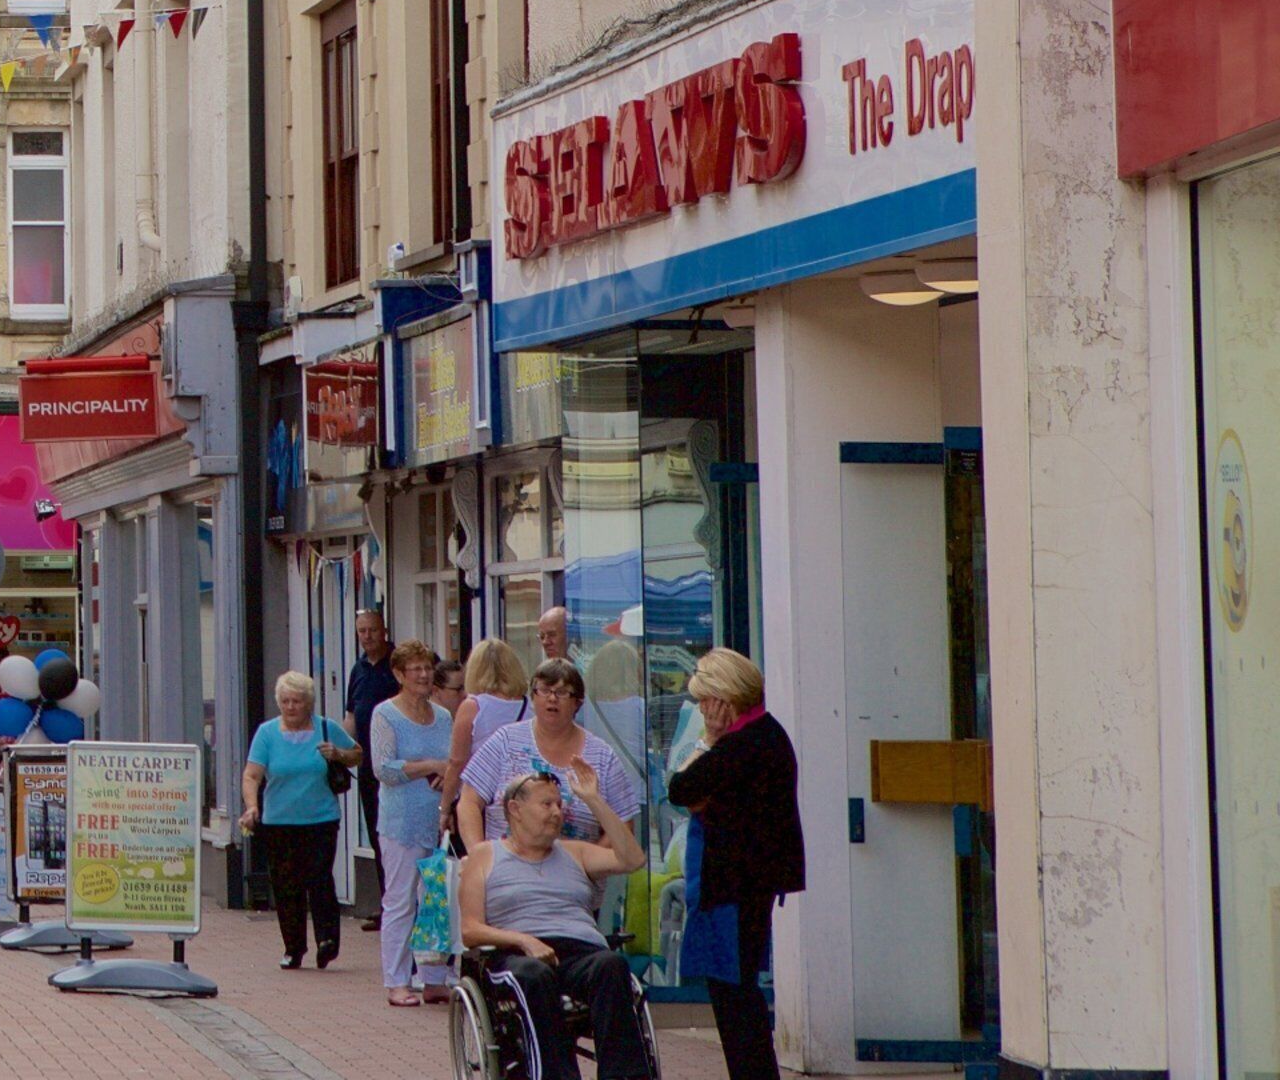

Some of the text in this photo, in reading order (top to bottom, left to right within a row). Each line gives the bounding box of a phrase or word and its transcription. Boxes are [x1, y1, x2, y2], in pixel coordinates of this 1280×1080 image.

[843, 38, 976, 155] The Drap
[28, 399, 148, 417] PRINCIPALITY
[77, 755, 192, 771] NEATH CARPET
[104, 769, 164, 784] CENTRE
[126, 787, 149, 800] into
[151, 787, 189, 802] Spring
[77, 813, 120, 830] FREE
[76, 842, 119, 859] FREE
[122, 881, 151, 892] 01639
